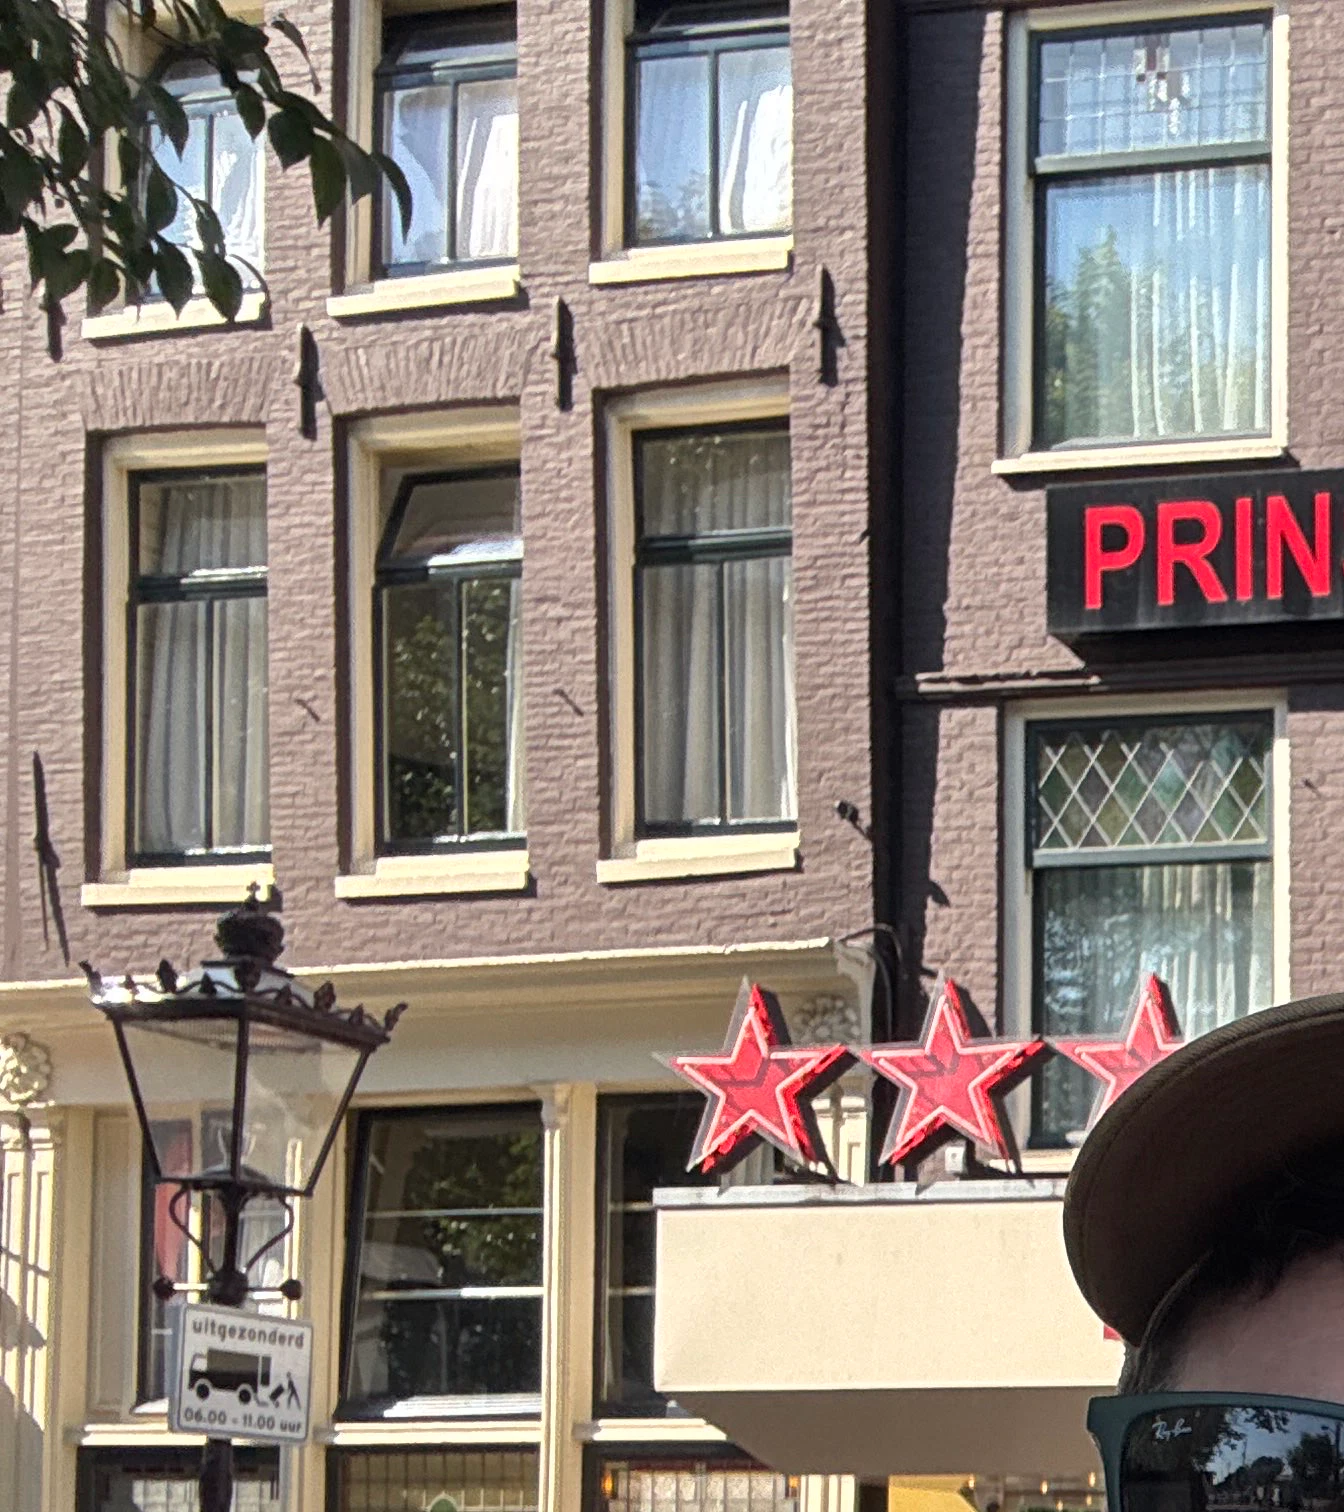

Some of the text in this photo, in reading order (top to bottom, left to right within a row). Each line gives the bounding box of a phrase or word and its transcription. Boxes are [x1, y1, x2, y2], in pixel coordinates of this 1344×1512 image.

[192, 1317, 305, 1349] uitgezonderd
[184, 1407, 227, 1427] 06.00
[242, 1413, 276, 1431] 11.00
[279, 1418, 303, 1433] uur
